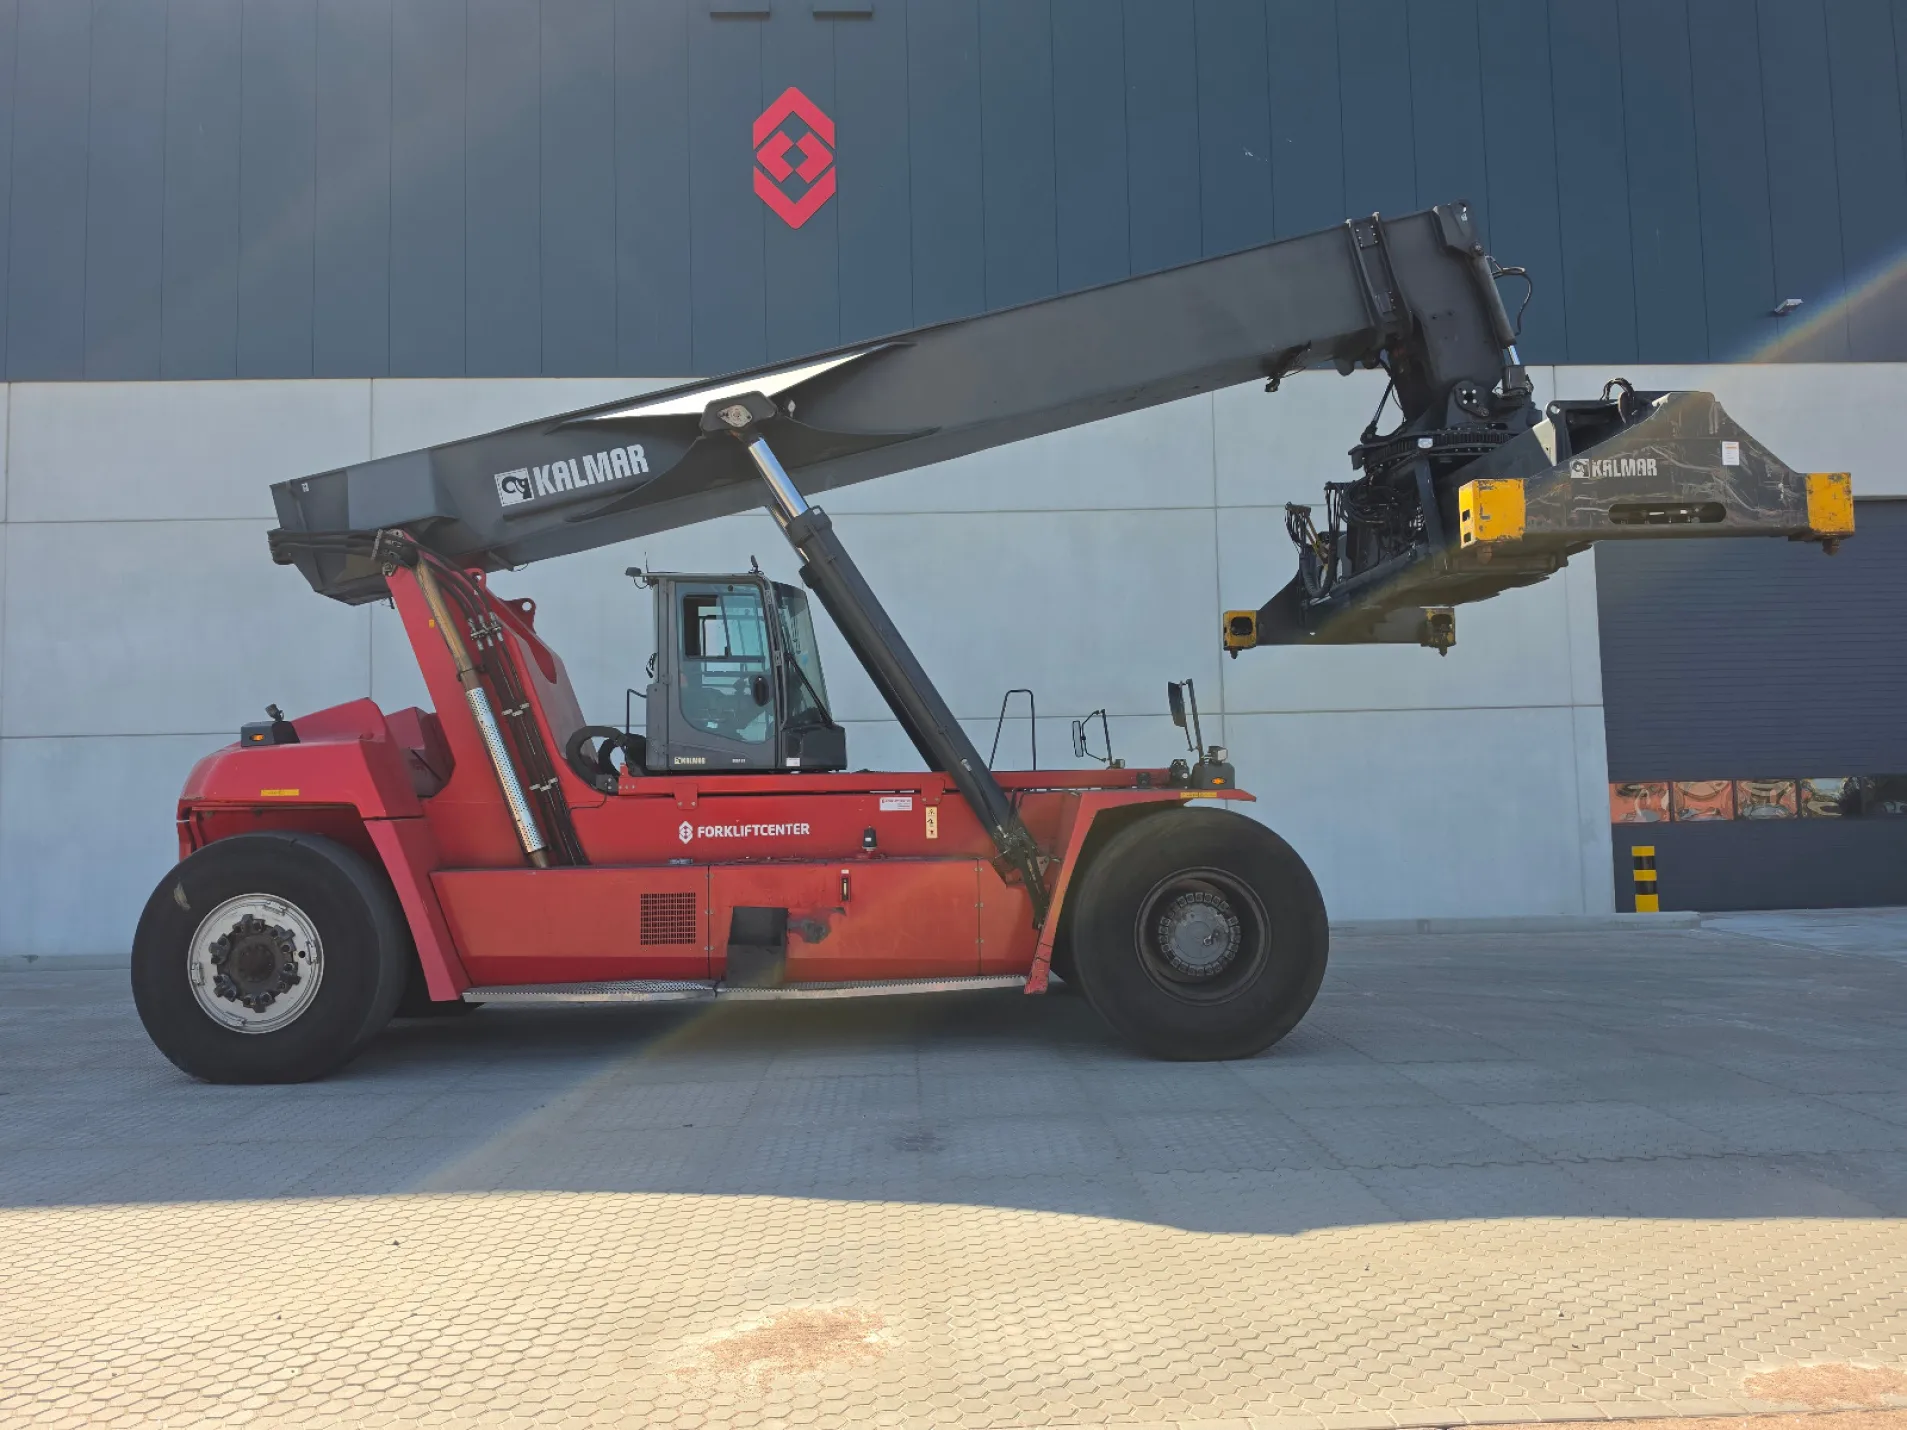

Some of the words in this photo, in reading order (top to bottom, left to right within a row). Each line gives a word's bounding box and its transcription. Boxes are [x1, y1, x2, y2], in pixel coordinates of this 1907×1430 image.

[533, 444, 649, 495] KALMAR
[1591, 458, 1658, 477] KALMAR
[697, 823, 810, 838] FORKLIFTCENTER
